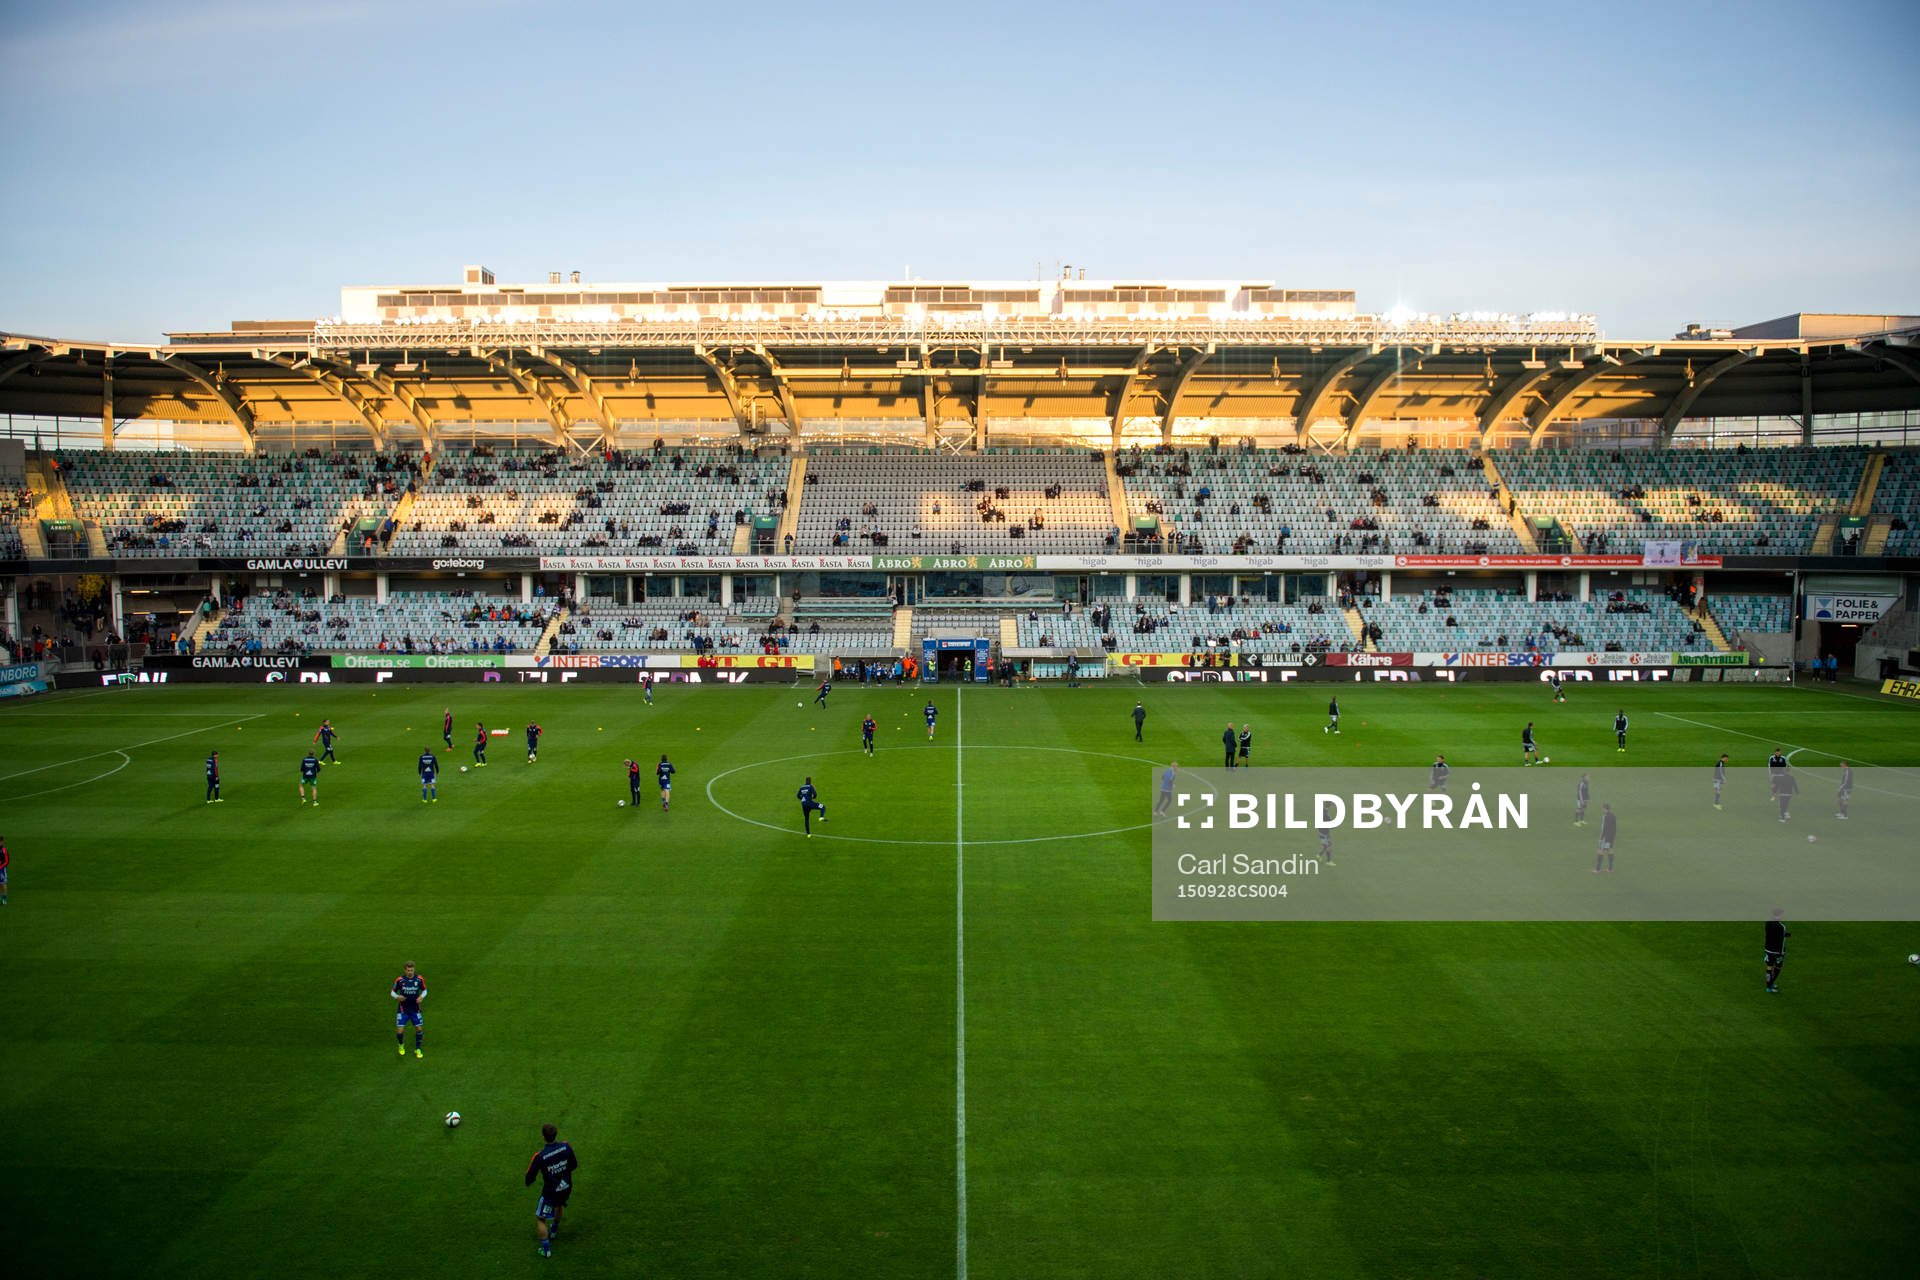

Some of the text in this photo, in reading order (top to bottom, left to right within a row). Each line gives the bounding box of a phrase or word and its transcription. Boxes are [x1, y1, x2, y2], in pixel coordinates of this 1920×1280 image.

[247, 560, 348, 569] GAMLA ULLEVI
[543, 560, 870, 568] RASTA RASTA RASTA RASTA RASTA RASTA RASTA RASTA RASTA RASTA RASTA RASTA
[1082, 557, 1384, 568] higab higab higab higab higab higab
[1836, 611, 1879, 620] PAPPER
[192, 657, 299, 668] GAMLA ULLEVI
[345, 656, 492, 668] Offerta.se Offerta.se
[553, 655, 648, 668] INTERSPORT
[757, 656, 798, 668] GT
[1122, 654, 1162, 665] GT
[1348, 654, 1392, 666] Kährs
